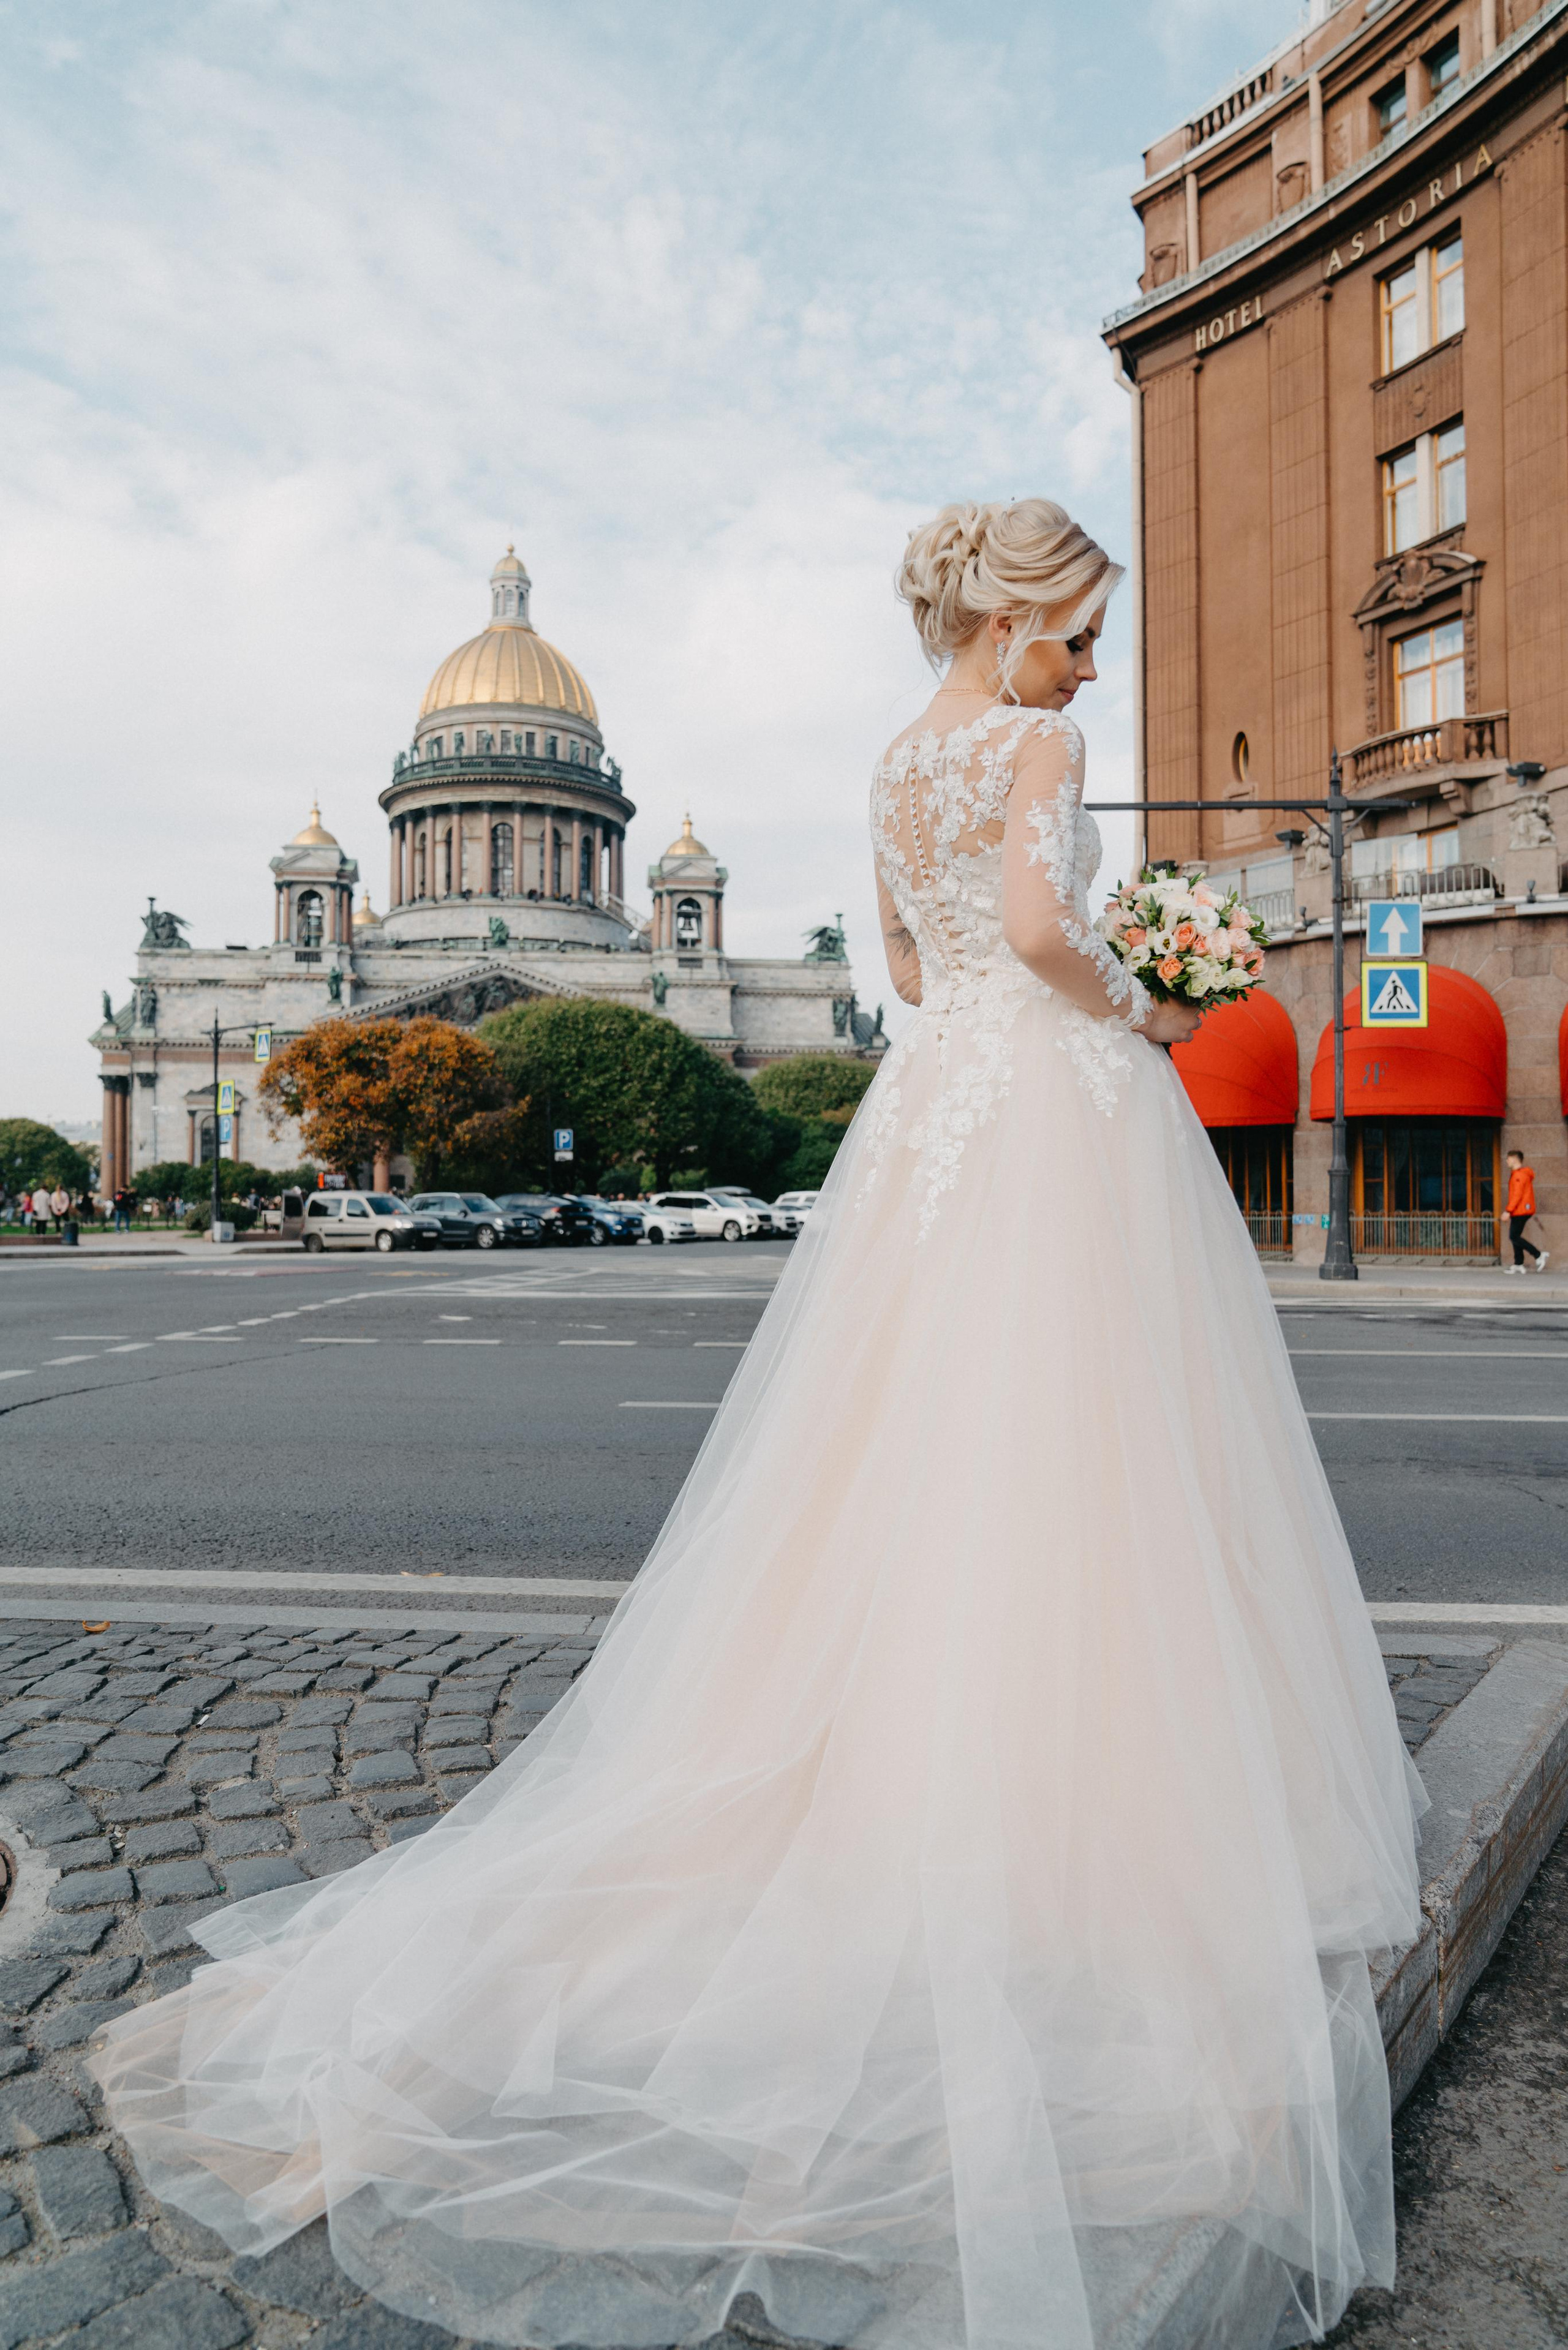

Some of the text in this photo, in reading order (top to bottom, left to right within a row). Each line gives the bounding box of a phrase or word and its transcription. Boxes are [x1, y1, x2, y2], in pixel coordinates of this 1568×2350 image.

[1195, 143, 1493, 352] HOTEL ASTORIA
[222, 1120, 230, 1139] P
[559, 1132, 570, 1148] P
